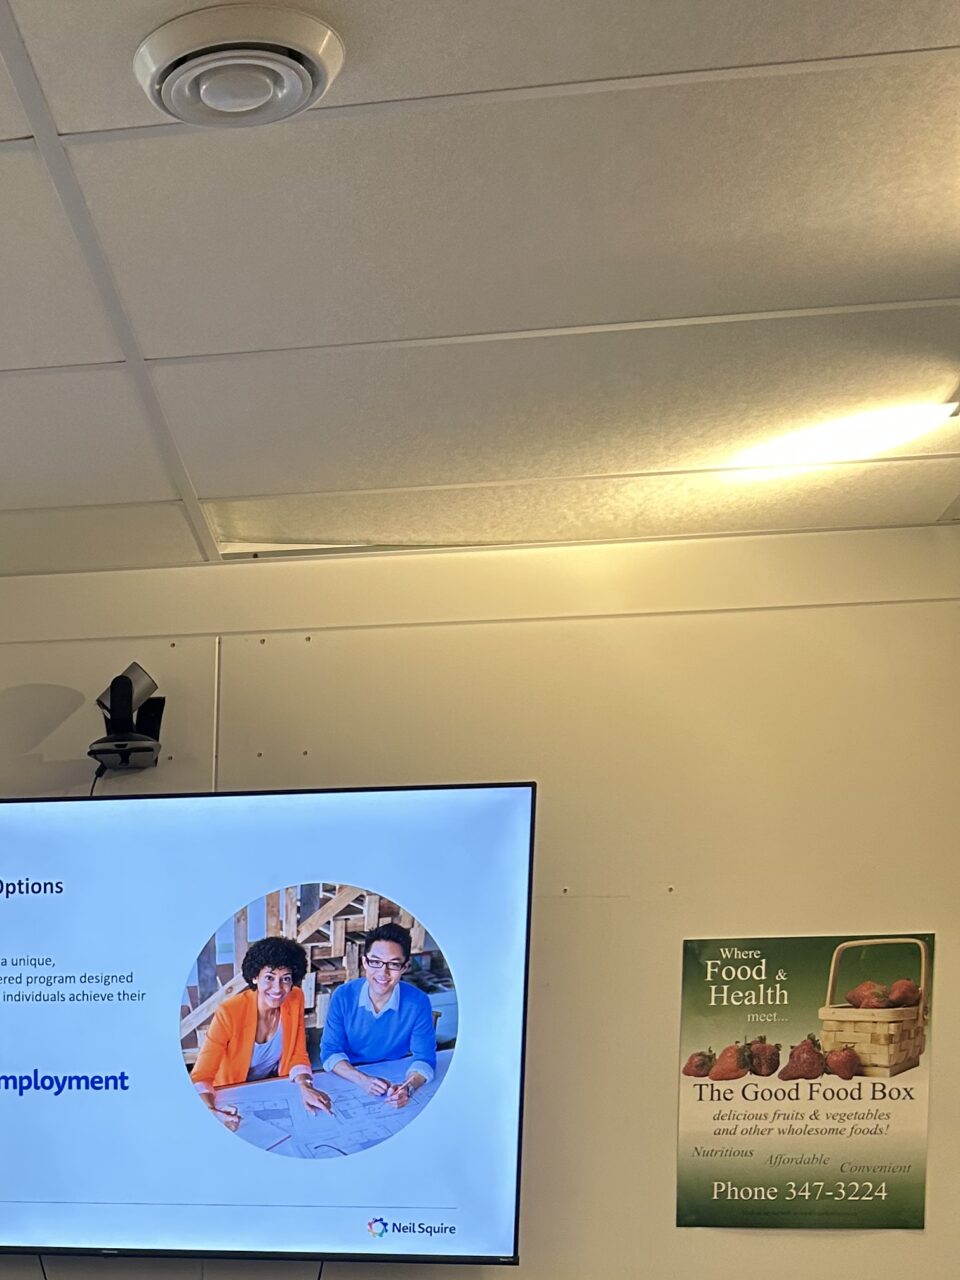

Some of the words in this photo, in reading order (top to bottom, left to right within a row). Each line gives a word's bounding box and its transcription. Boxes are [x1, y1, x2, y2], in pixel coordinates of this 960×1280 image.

[720, 948, 761, 959] Where
[1, 958, 7, 967] a
[11, 955, 56, 969] unique,
[705, 959, 767, 981] Food
[775, 969, 788, 981] &
[26, 974, 76, 986] program
[79, 972, 133, 986] designed
[3, 990, 65, 1002] individuals
[69, 990, 114, 1002] achieve
[117, 989, 146, 1001] their
[709, 984, 789, 1006] Health
[747, 1012, 789, 1022] meet...
[694, 1083, 734, 1101] The
[741, 1082, 800, 1101] Good
[807, 1082, 862, 1101] Food
[871, 1083, 915, 1100] Box
[713, 1109, 768, 1121] delicious
[769, 1109, 805, 1123] fruits
[809, 1110, 820, 1121] &
[825, 1109, 891, 1122] vegetables
[713, 1124, 737, 1136] and
[740, 1125, 773, 1136] other
[777, 1124, 846, 1136] wholesome
[847, 1124, 890, 1137] foods!
[691, 1146, 754, 1158] Nutritious
[764, 1153, 830, 1166] Affordable
[840, 1161, 911, 1173] Convenient
[712, 1181, 778, 1201] Phone
[785, 1182, 888, 1200] 347-3224
[392, 1223, 416, 1233] Neil
[418, 1223, 456, 1236] Squire
